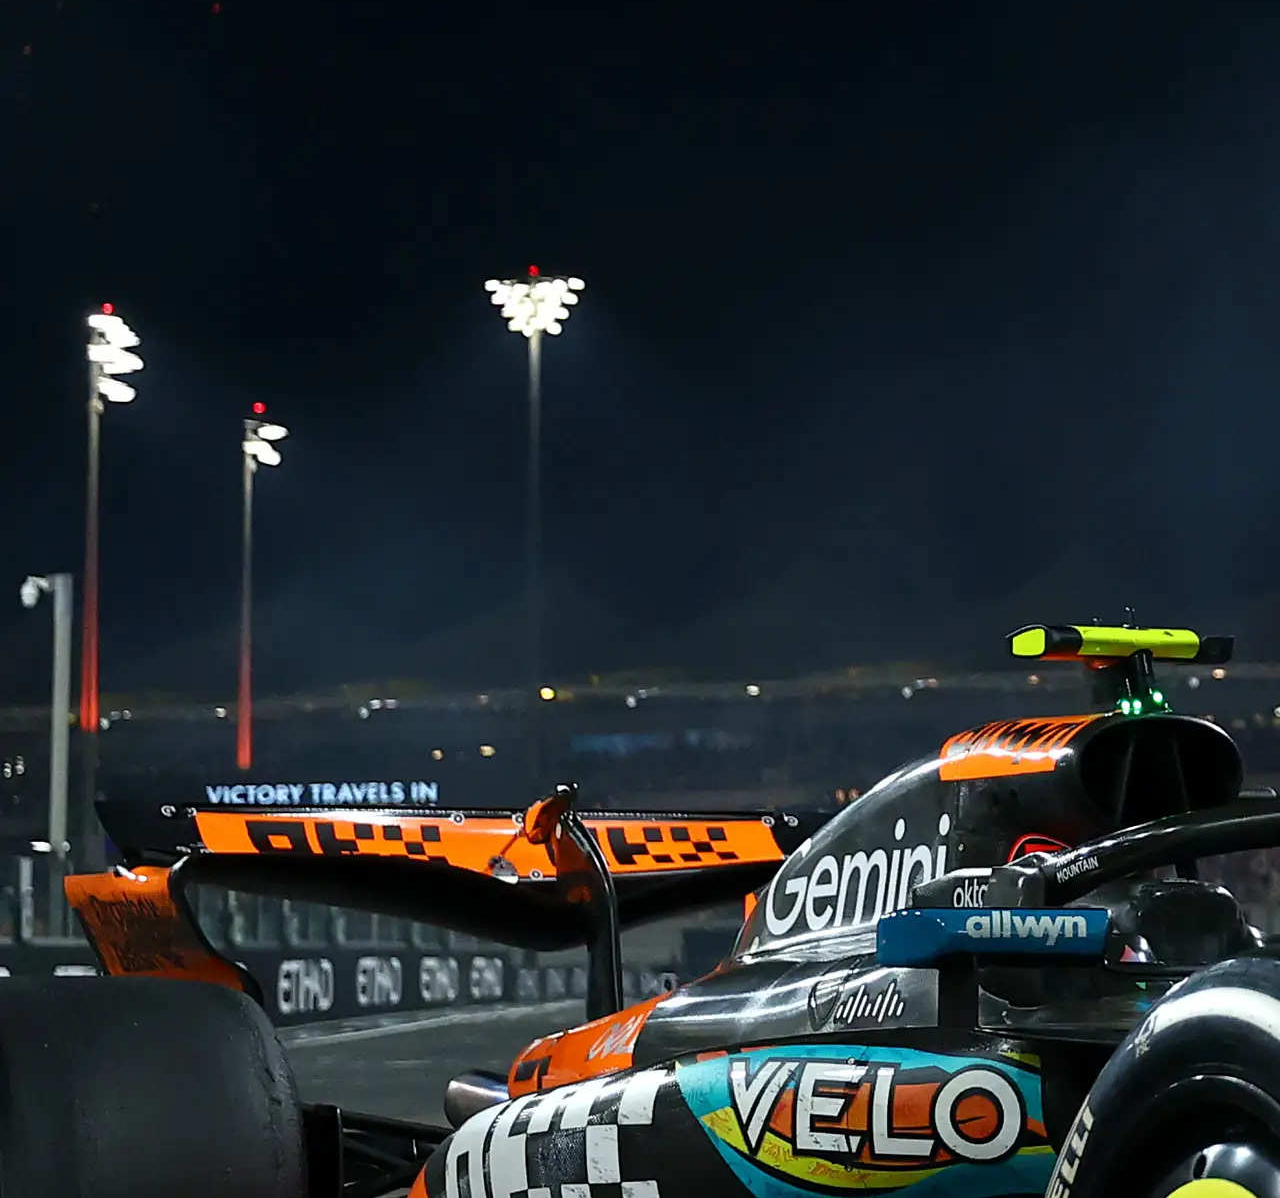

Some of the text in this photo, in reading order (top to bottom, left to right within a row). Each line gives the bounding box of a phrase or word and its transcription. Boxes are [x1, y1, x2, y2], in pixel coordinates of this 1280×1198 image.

[206, 781, 438, 805] VICTORY TRAVELS IN
[765, 813, 951, 936] Gemini
[1056, 855, 1100, 884] MOUNTAIN
[965, 910, 1087, 946] allwyn
[730, 1059, 1023, 1161] VELO
